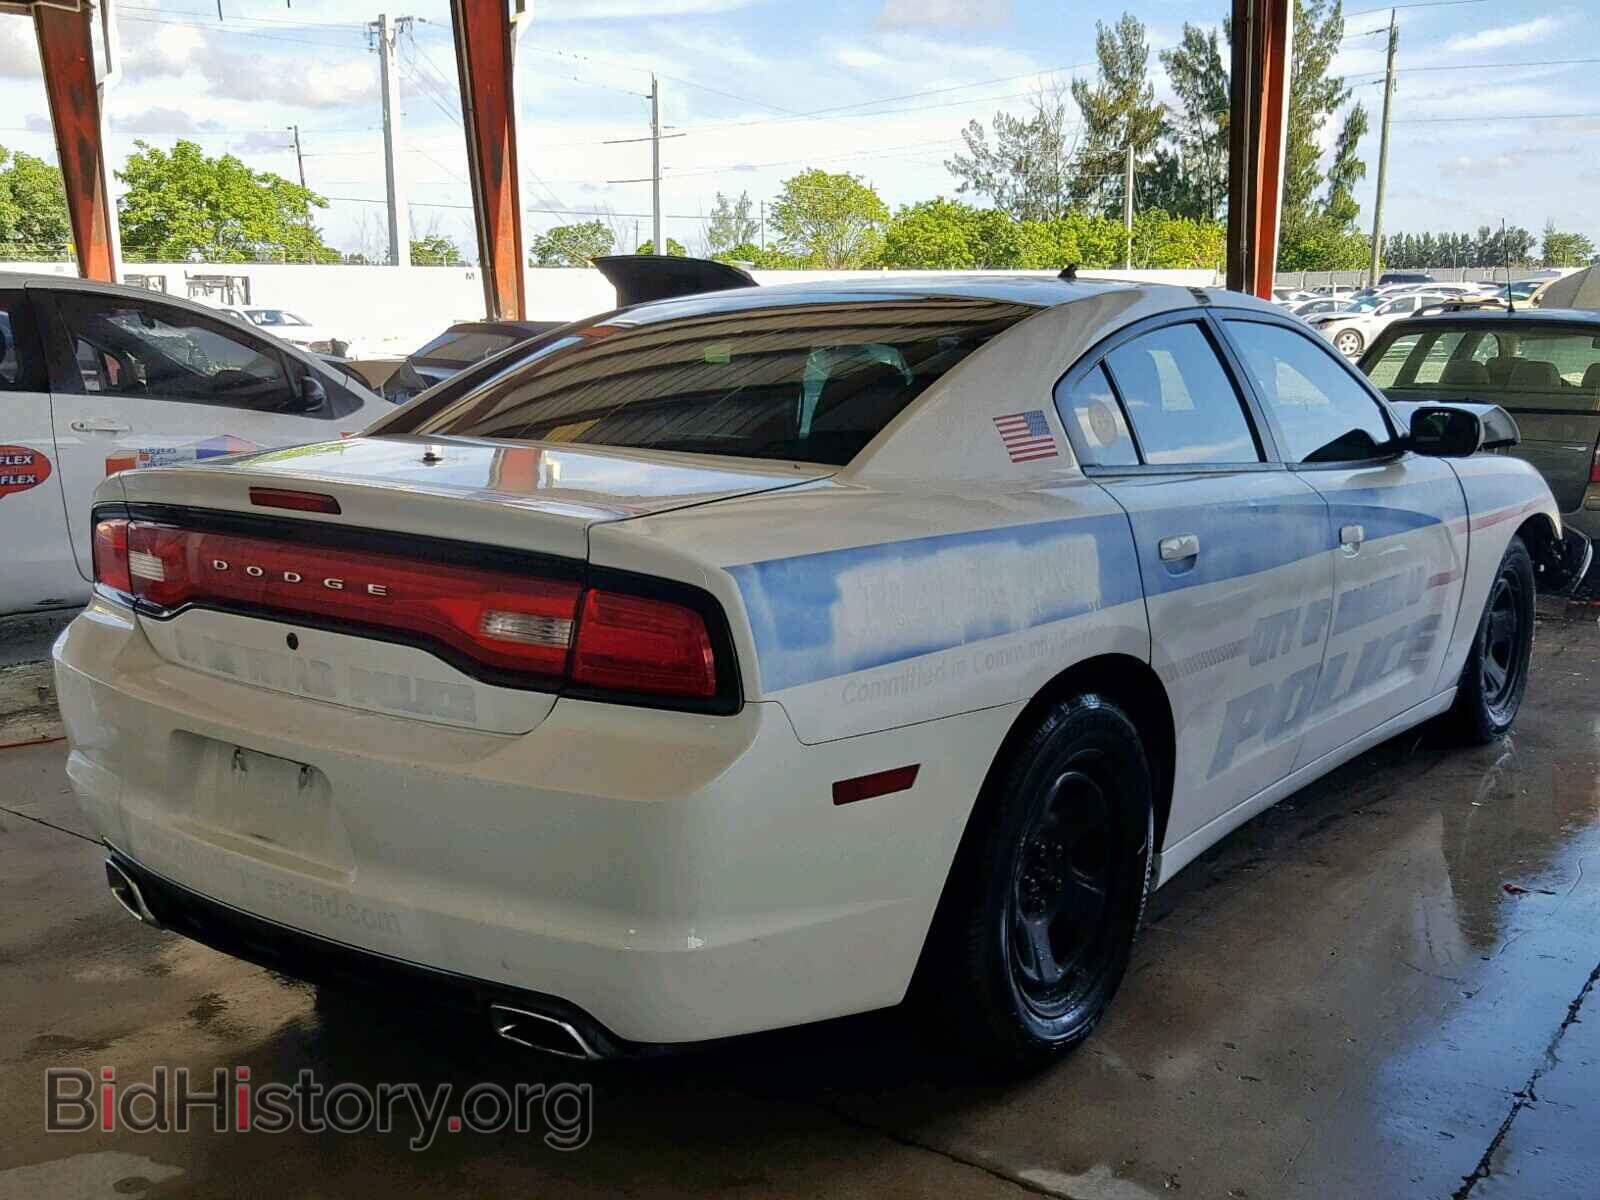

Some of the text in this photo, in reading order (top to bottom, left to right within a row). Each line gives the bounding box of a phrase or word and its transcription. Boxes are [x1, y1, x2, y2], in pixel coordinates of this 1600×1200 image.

[0, 455, 33, 465] FLEX
[0, 475, 36, 485] FLEX
[213, 559, 388, 596] DODGE
[1206, 613, 1442, 781] POLICE
